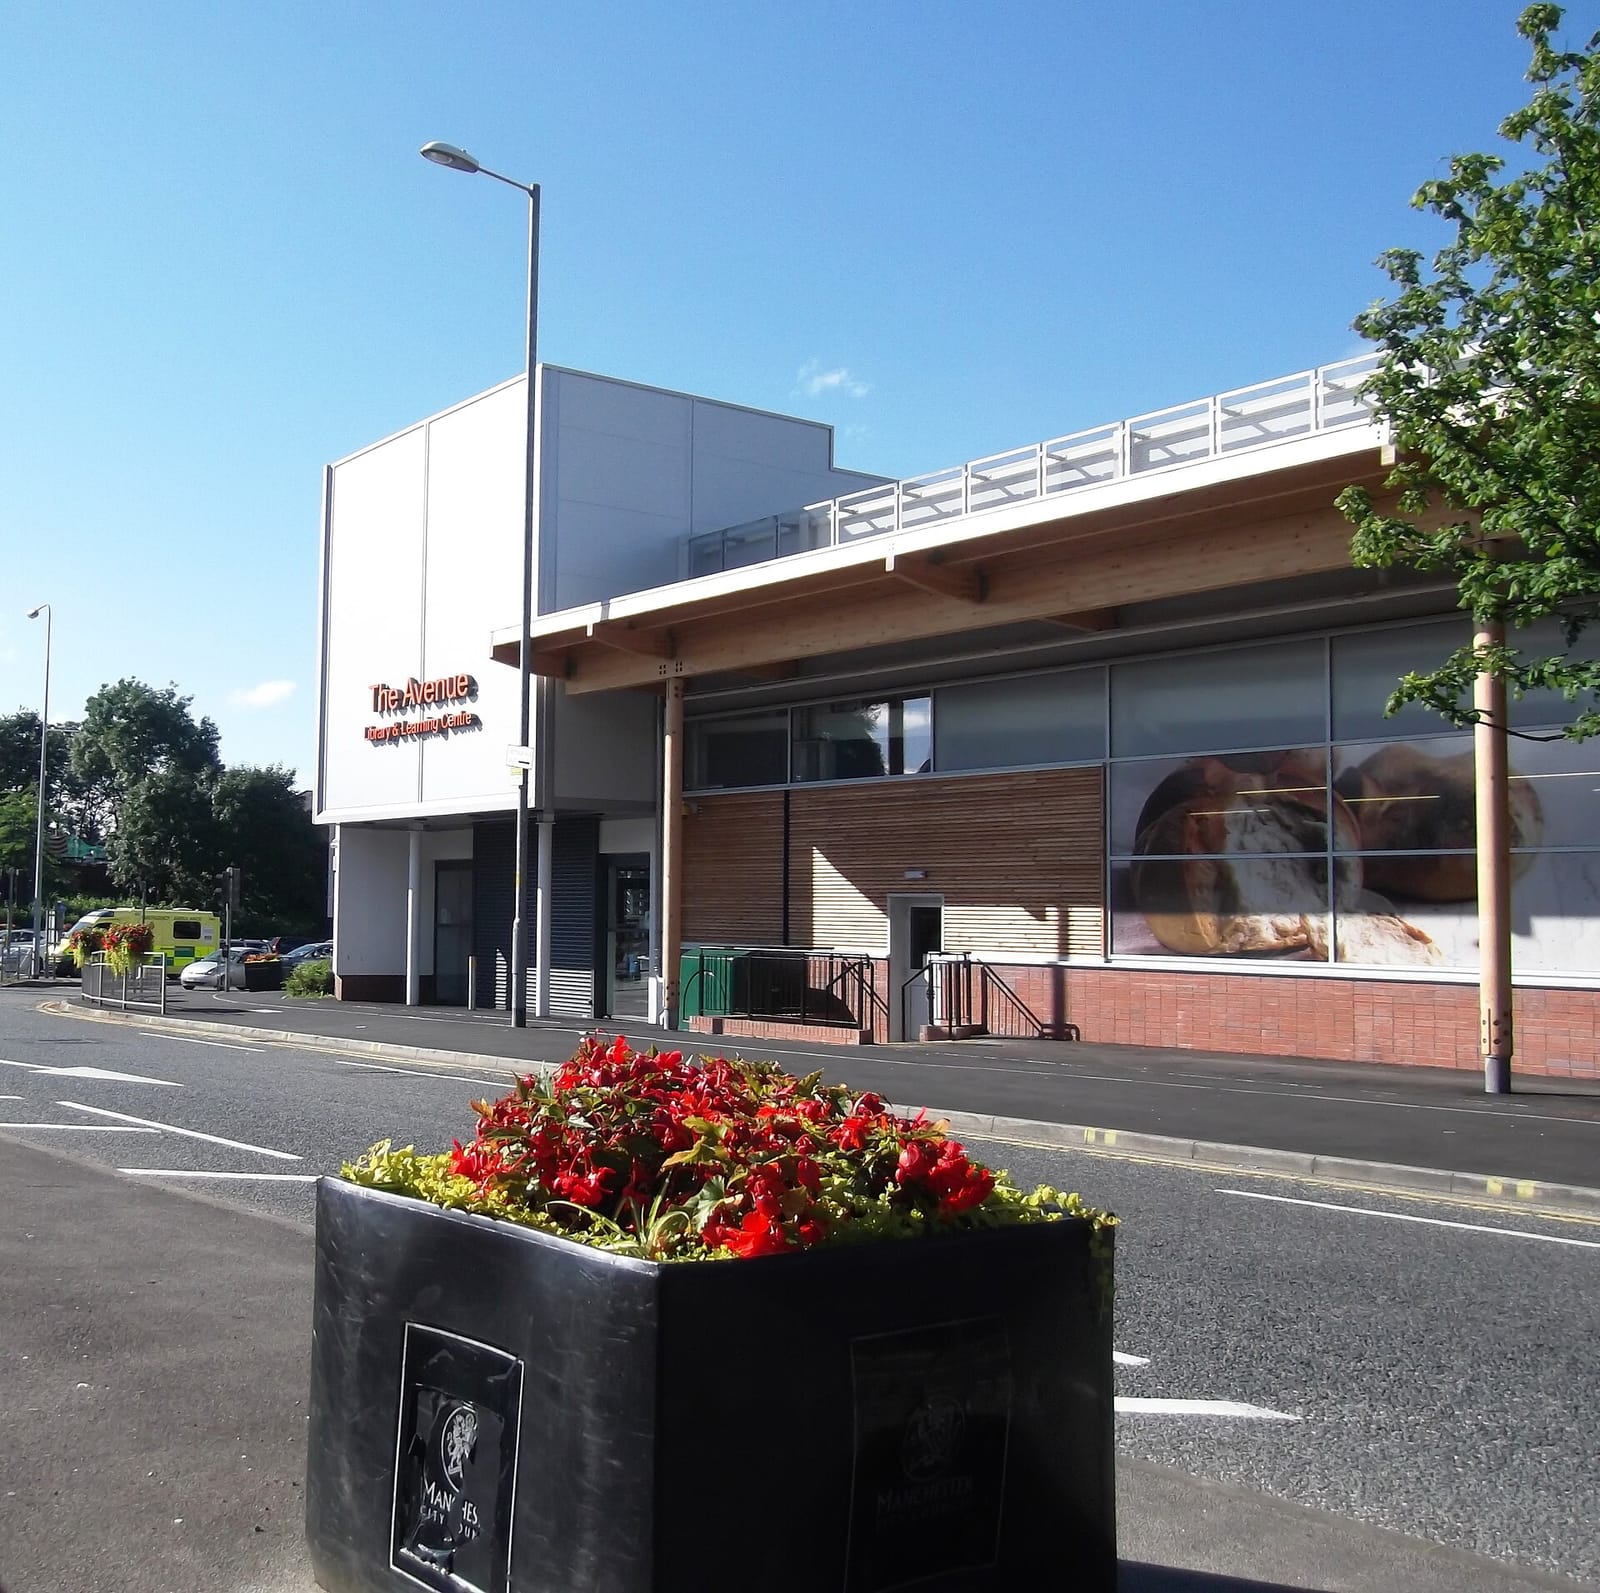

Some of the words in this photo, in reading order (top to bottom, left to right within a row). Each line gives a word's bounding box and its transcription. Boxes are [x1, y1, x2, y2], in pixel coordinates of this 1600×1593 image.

[368, 684, 399, 712] The
[402, 673, 468, 707] Avenue
[365, 726, 391, 741] Library
[391, 724, 398, 737] &
[401, 717, 439, 735] Learning
[441, 711, 471, 729] Centre
